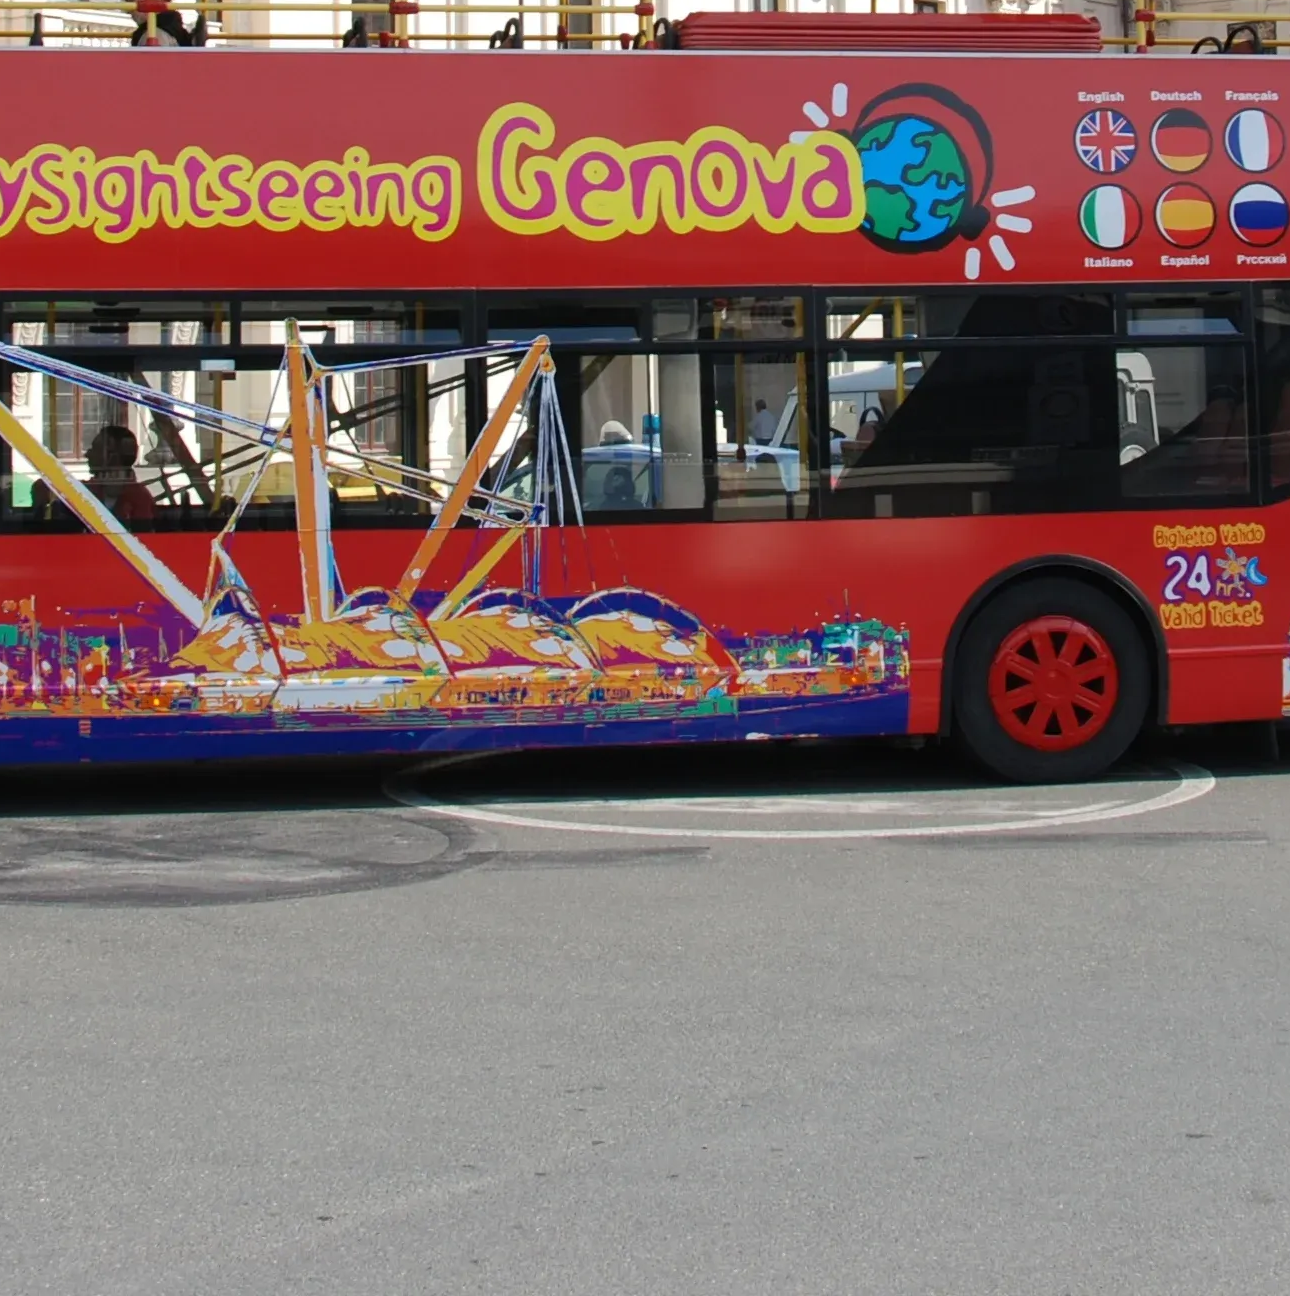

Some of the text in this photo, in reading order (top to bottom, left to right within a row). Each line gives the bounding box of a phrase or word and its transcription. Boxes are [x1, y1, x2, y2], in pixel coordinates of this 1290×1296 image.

[1077, 91, 1124, 103] English
[1150, 90, 1202, 101] Deutsch
[1225, 90, 1279, 102] Français
[477, 102, 866, 241] Genova
[1084, 257, 1134, 268] Italiano
[1160, 255, 1210, 268] Español
[1164, 554, 1212, 600] 24
[1160, 601, 1264, 628] Valid Ticket
